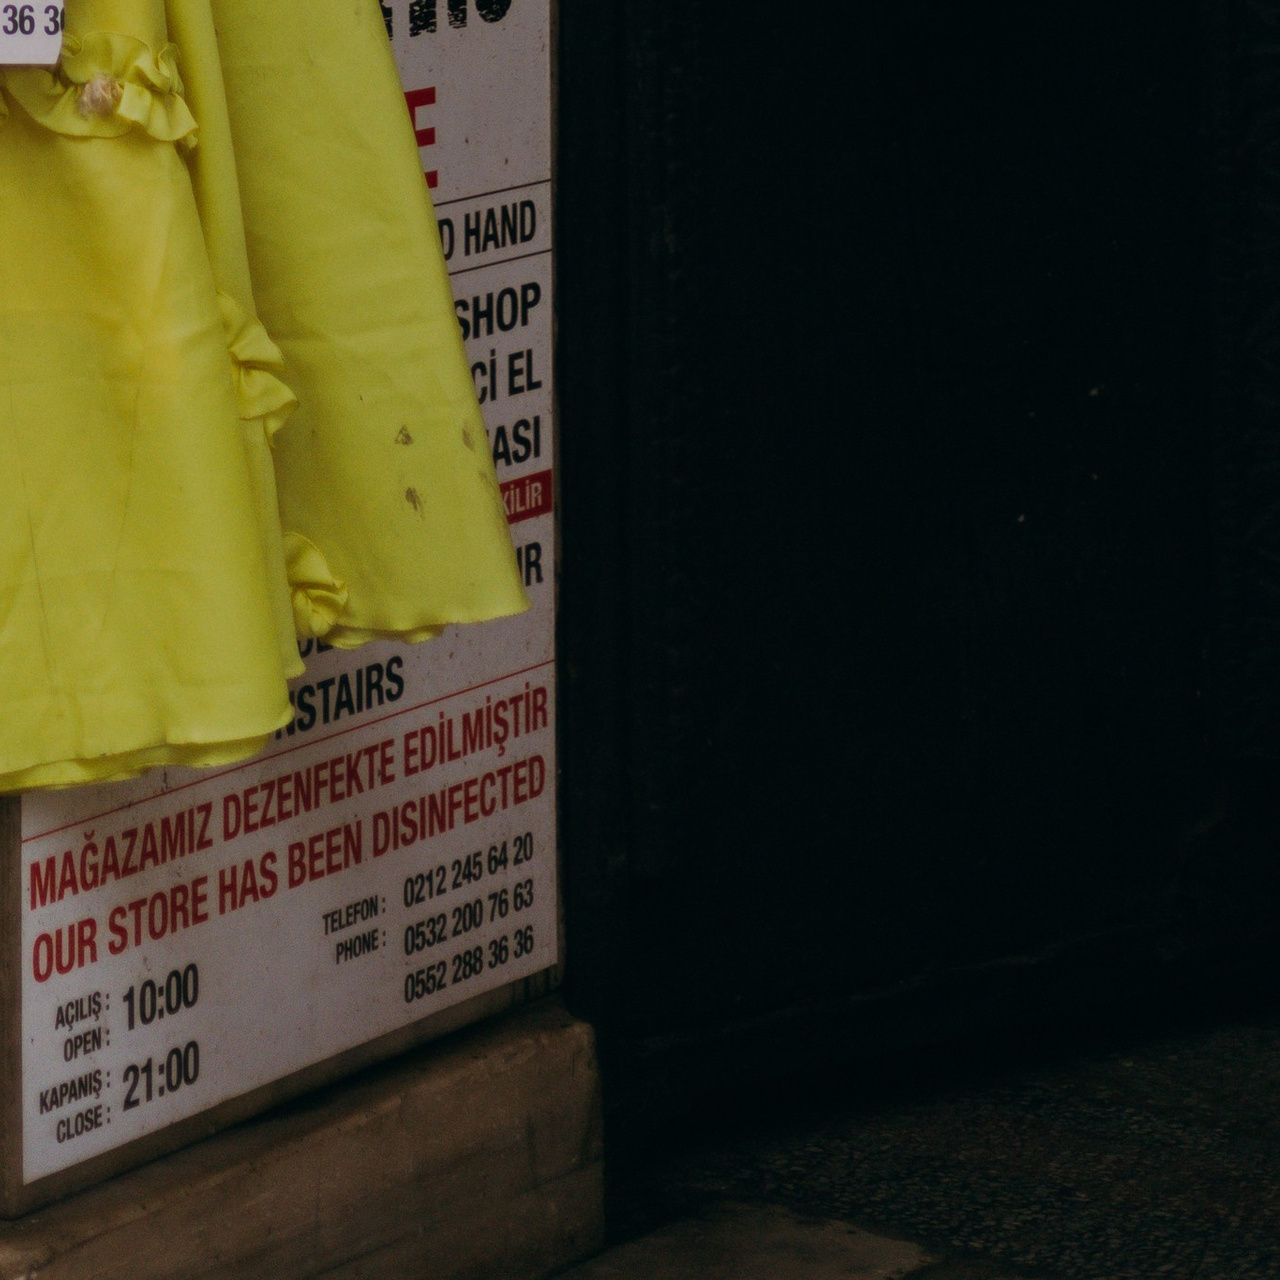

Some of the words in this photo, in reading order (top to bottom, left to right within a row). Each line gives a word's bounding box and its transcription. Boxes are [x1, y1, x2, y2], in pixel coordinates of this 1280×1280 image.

[2, 5, 35, 35] 36
[464, 200, 536, 258] HAND
[453, 282, 541, 341] SHOP
[508, 348, 542, 397] EL
[501, 480, 543, 516] KİLİR
[276, 656, 404, 739] STAIRS
[30, 802, 213, 911] MAĞAZAMIZ
[223, 739, 395, 842] DEZENFEKTE
[404, 681, 548, 777] EDİLMİŞTİR
[33, 917, 97, 983] OUR
[108, 875, 209, 955] STORE
[219, 851, 278, 915] HAS
[288, 820, 362, 889] BEEN
[373, 754, 545, 858] DISINFECTED
[403, 865, 446, 908] 0212
[451, 851, 483, 890] 245
[487, 841, 508, 876] 64
[513, 831, 534, 866] 20
[322, 895, 379, 935] TELEFON
[404, 913, 447, 956] 0532
[451, 898, 483, 937] 200
[488, 888, 509, 922] 76
[513, 878, 534, 913] 63
[336, 928, 379, 965] PHONE
[404, 960, 447, 1003] 0552
[451, 945, 483, 985] 288
[488, 935, 509, 969] 36
[513, 925, 535, 959] 36
[55, 991, 102, 1031] AÇILIŞ
[123, 963, 199, 1031] 10:00
[63, 1027, 102, 1062] OPEN
[39, 1069, 103, 1115] KAPANIŞ
[123, 1040, 200, 1111] 21:00
[56, 1104, 103, 1144] CLOSE
